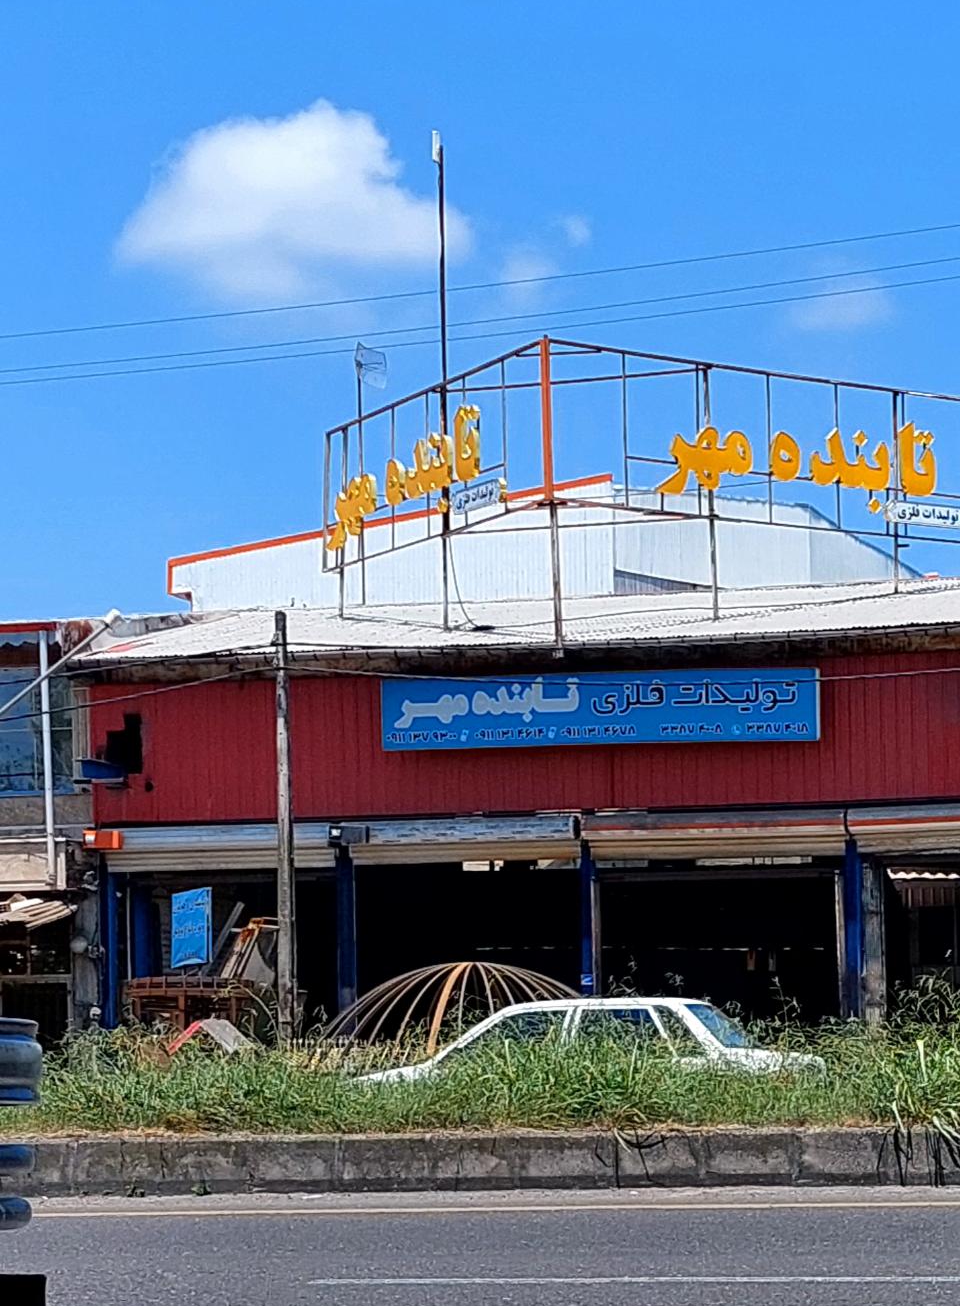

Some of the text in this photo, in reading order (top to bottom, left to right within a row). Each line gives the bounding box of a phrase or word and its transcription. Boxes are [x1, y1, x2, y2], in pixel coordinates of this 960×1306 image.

[326, 405, 480, 551] تابنده مهر
[471, 482, 494, 502] تولیدات
[656, 421, 936, 514] تابنده مهر
[897, 504, 959, 525] تولیدات فلزی
[394, 676, 798, 729] تولیدات فلزی تابنده مهر
